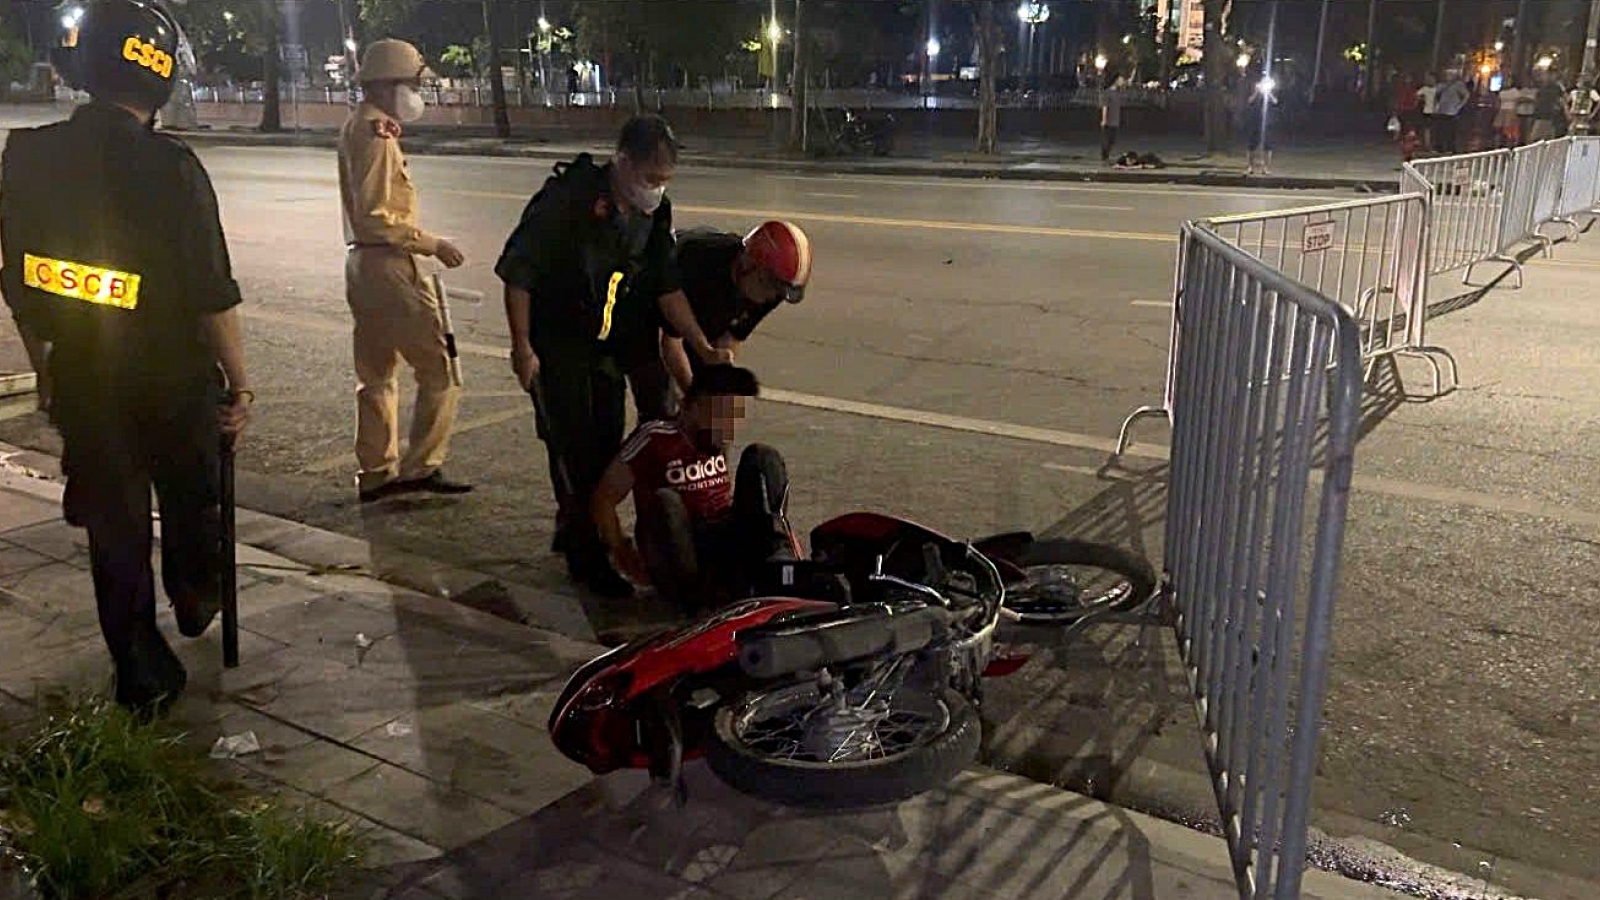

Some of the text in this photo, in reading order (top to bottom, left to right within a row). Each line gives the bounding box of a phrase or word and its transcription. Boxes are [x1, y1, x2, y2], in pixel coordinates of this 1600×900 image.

[1307, 233, 1330, 249] STOP
[36, 263, 127, 299] CSCĐ
[665, 455, 727, 484] adida
